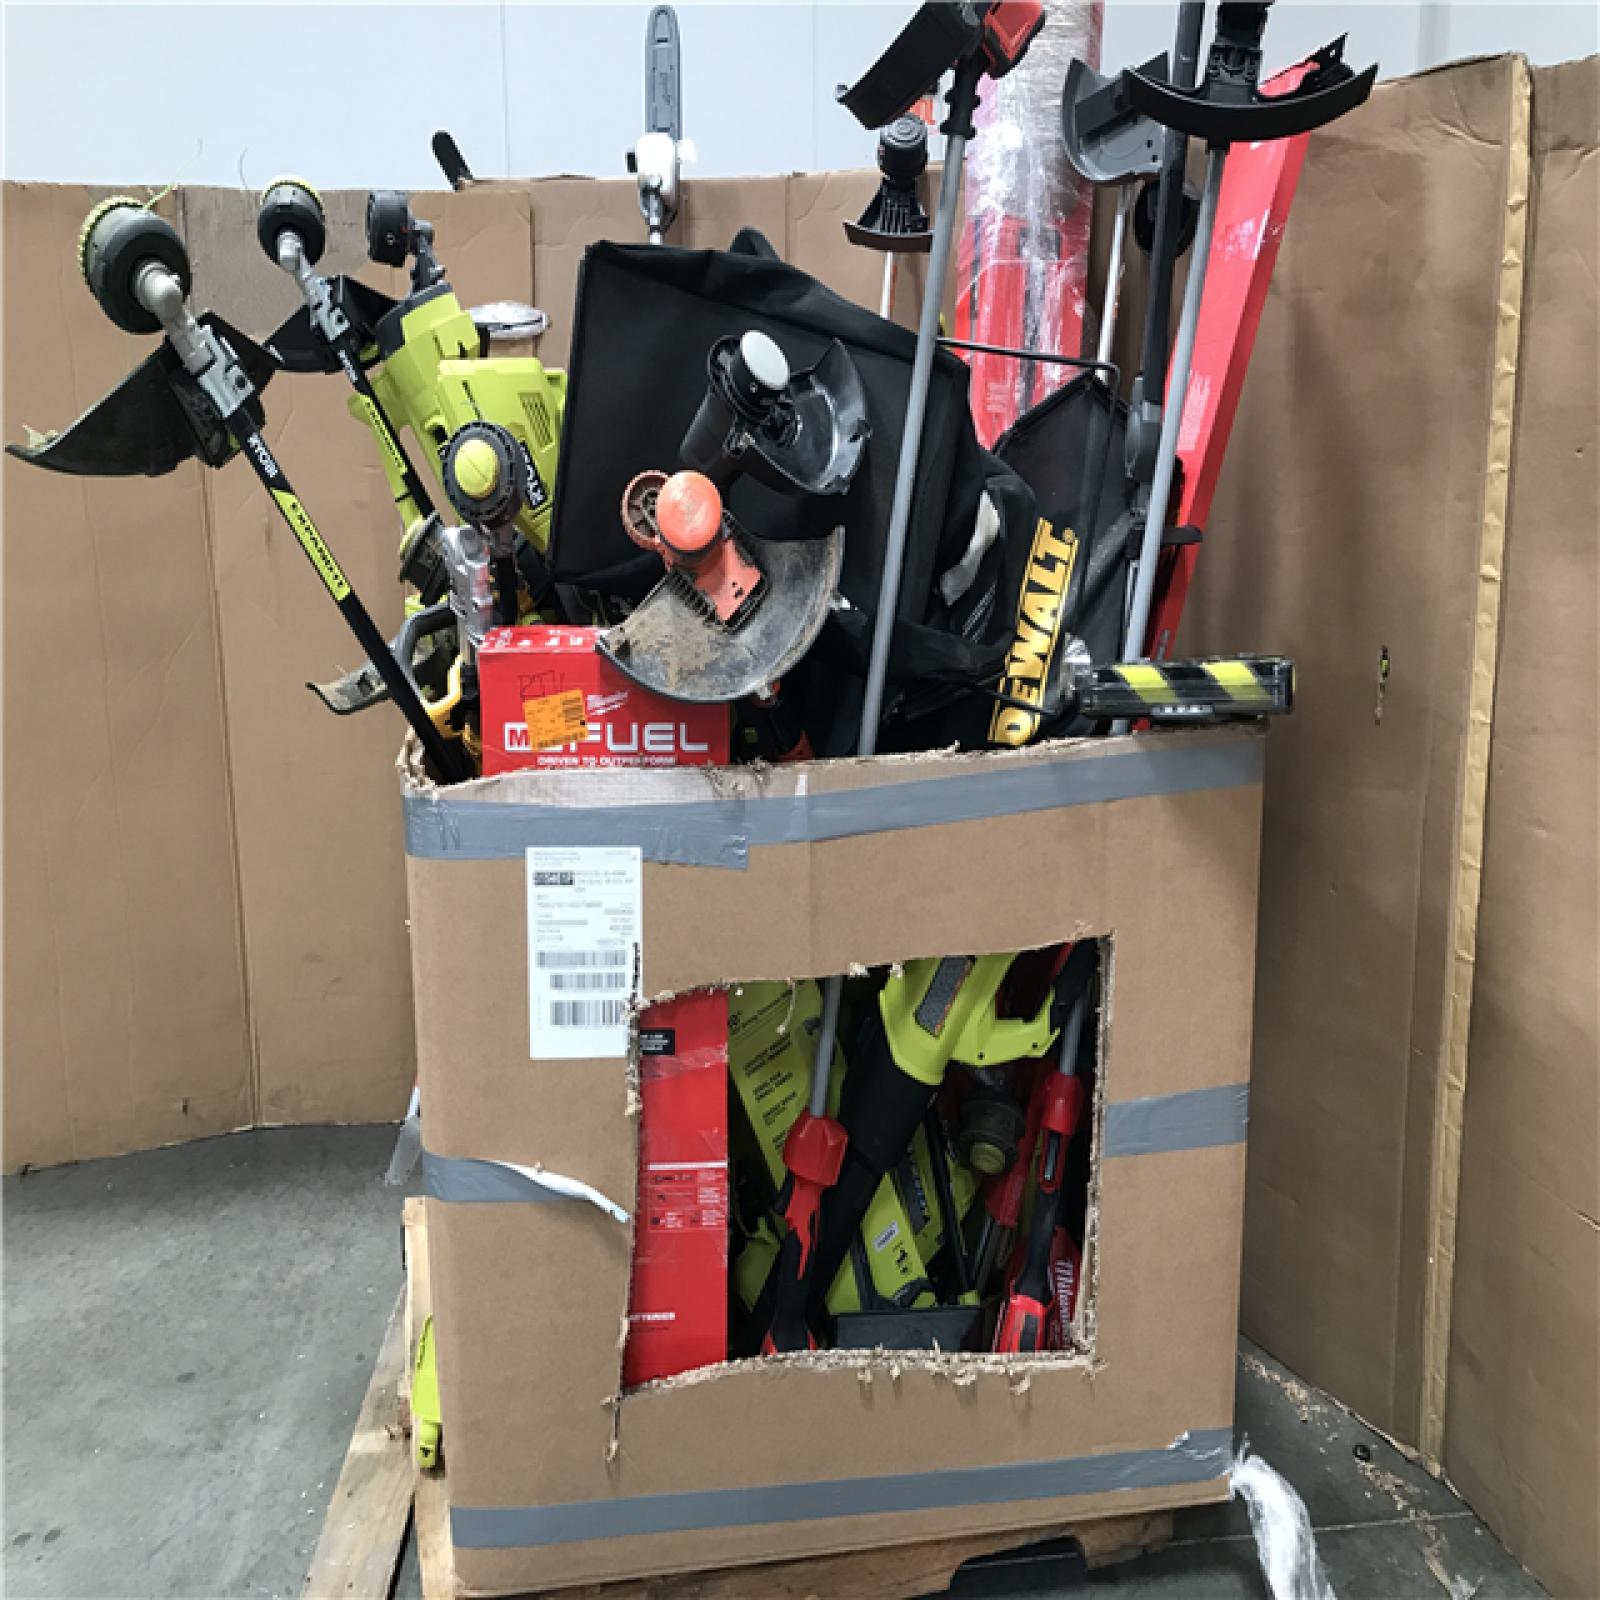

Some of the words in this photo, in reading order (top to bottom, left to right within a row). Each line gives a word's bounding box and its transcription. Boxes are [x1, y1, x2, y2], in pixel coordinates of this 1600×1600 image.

[248, 432, 278, 477] RYOBI
[988, 516, 1079, 747] DEWALT
[582, 755, 597, 767] TO
